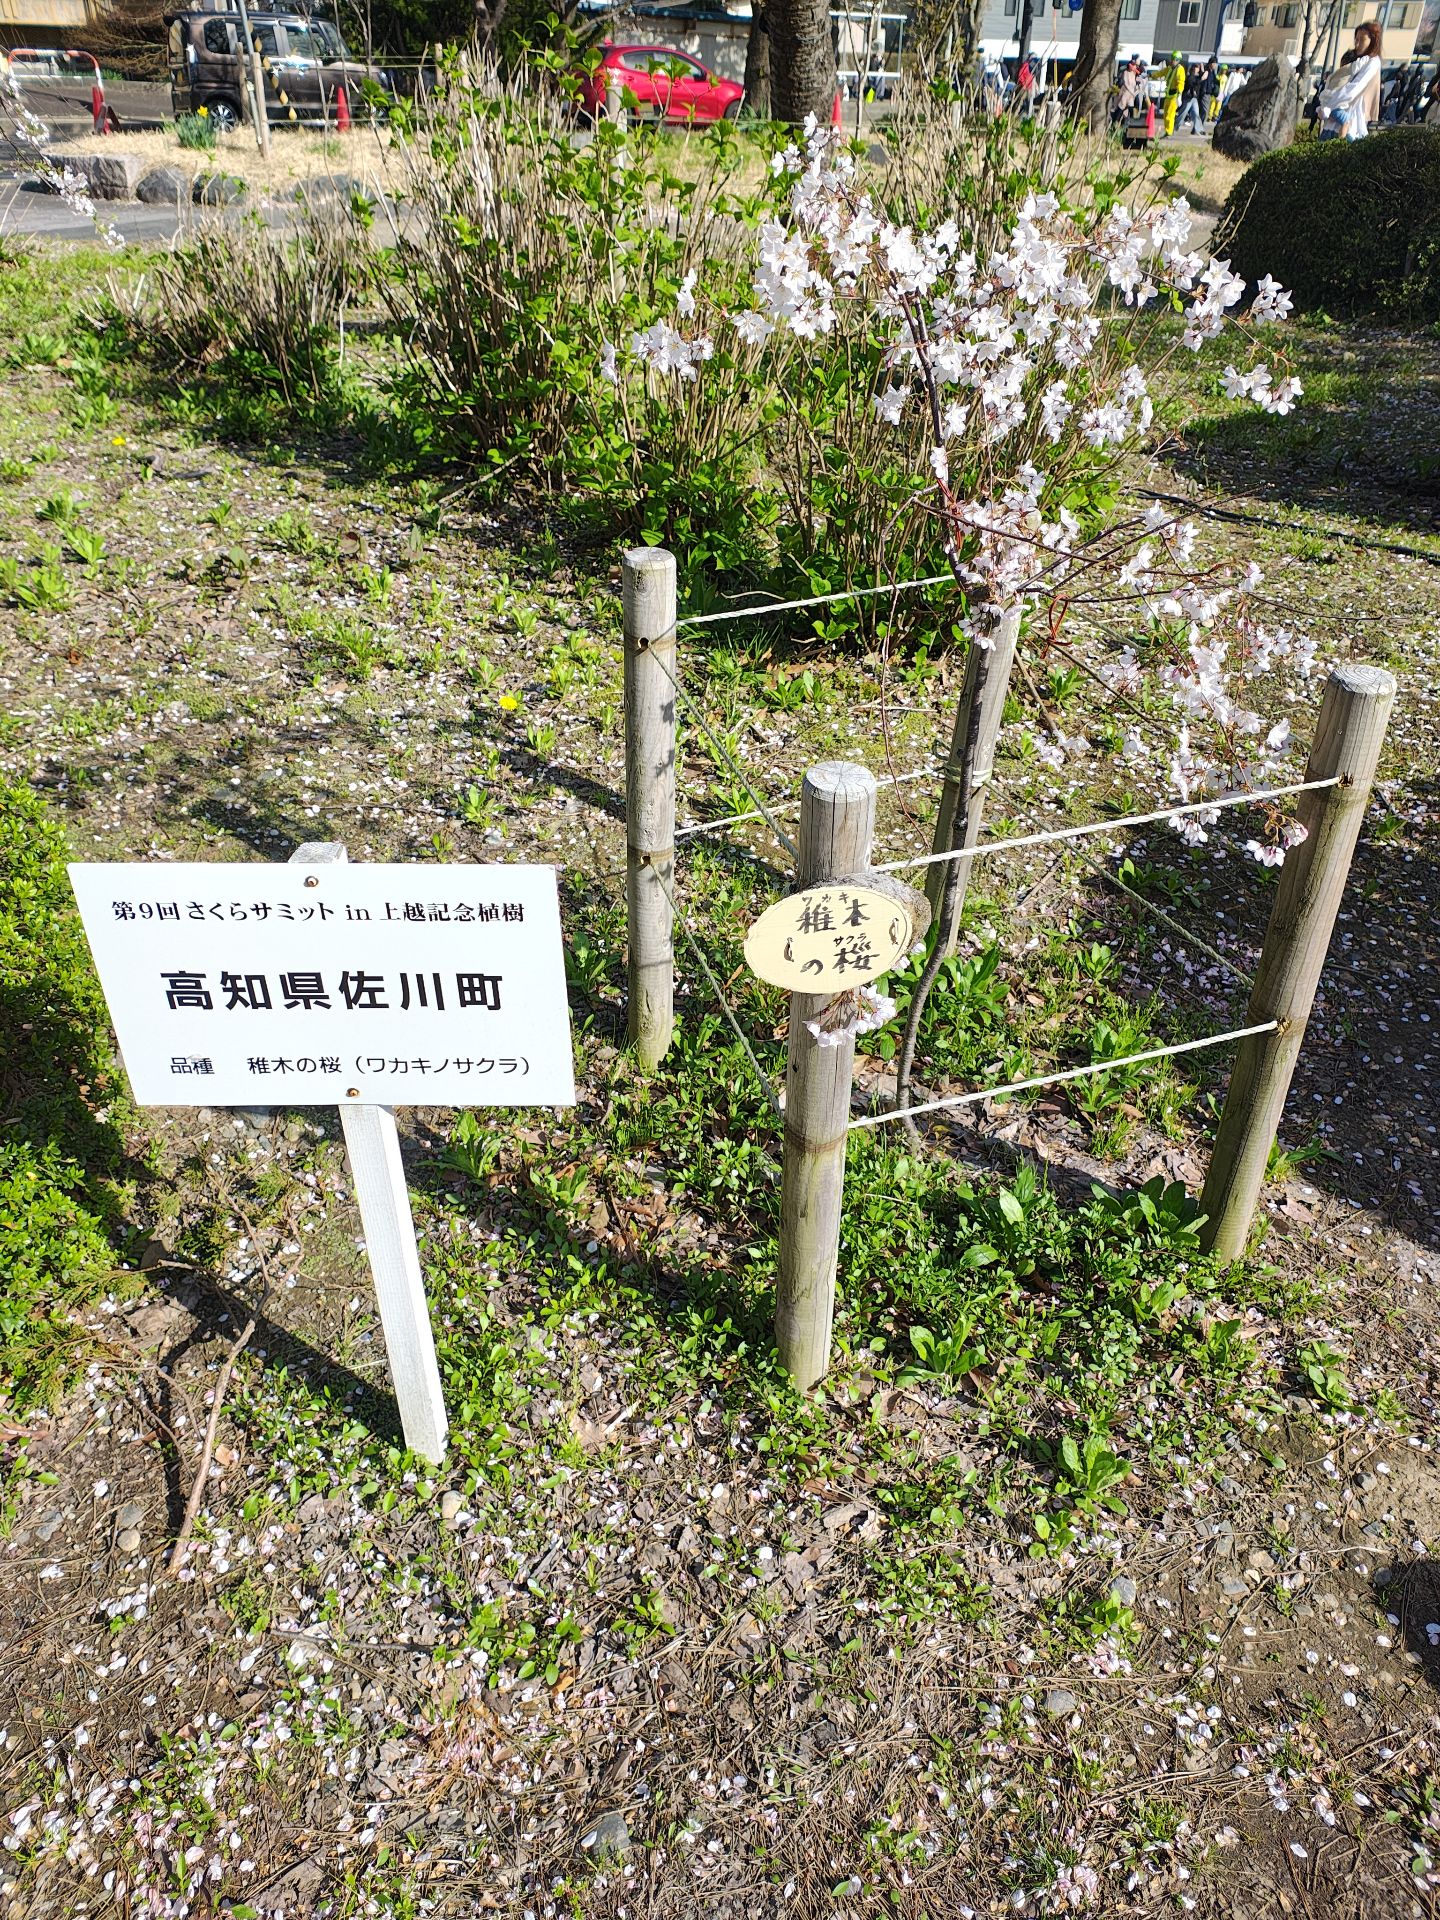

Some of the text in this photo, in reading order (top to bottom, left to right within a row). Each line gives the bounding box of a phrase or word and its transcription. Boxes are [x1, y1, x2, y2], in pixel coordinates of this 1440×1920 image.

[344, 904, 373, 921] in
[380, 902, 526, 923] 上越記念植樹
[833, 932, 867, 947] サクラ
[159, 970, 504, 1011] 高知県佐川町
[170, 1057, 215, 1075] 品種
